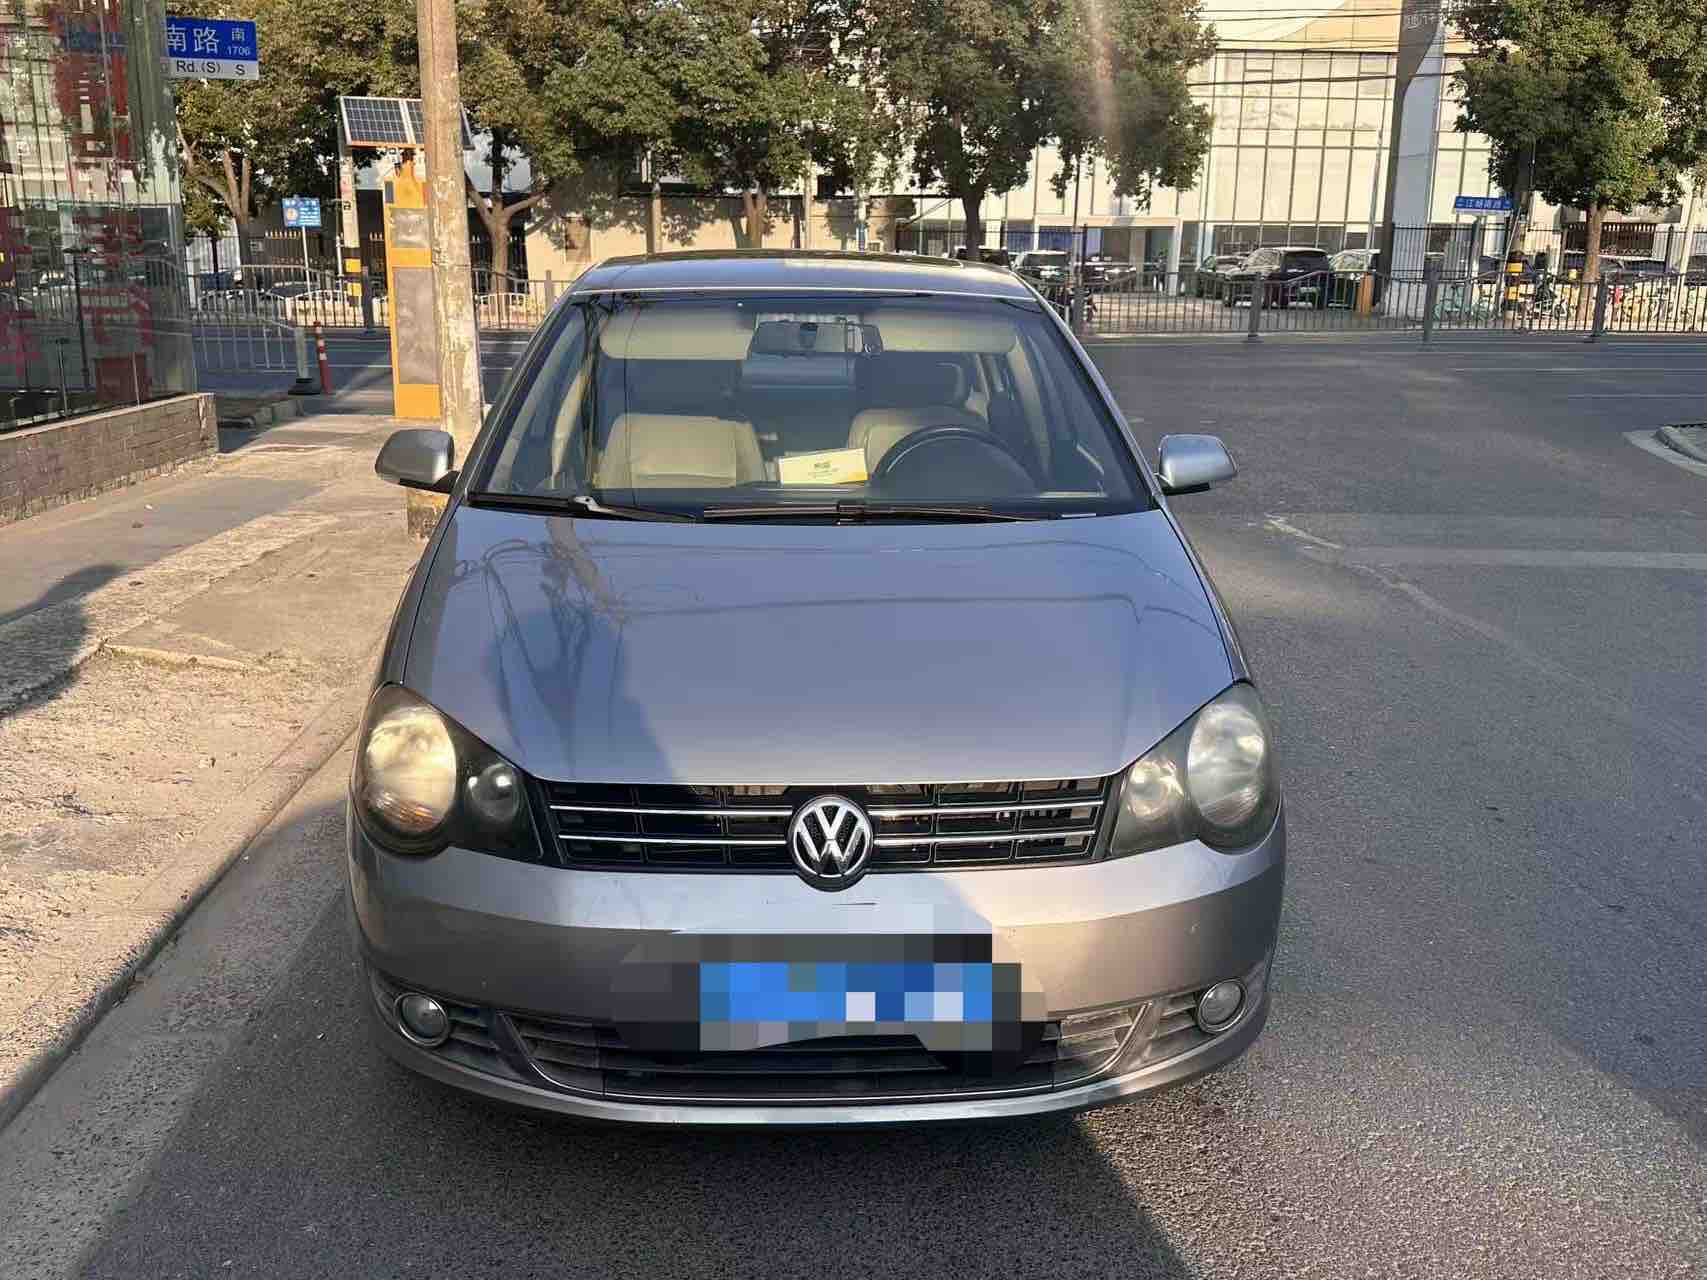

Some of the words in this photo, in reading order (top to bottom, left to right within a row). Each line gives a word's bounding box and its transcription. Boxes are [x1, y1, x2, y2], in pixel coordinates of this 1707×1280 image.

[167, 24, 220, 54] 南路
[234, 64, 246, 76] S
[792, 797, 868, 878] VW
